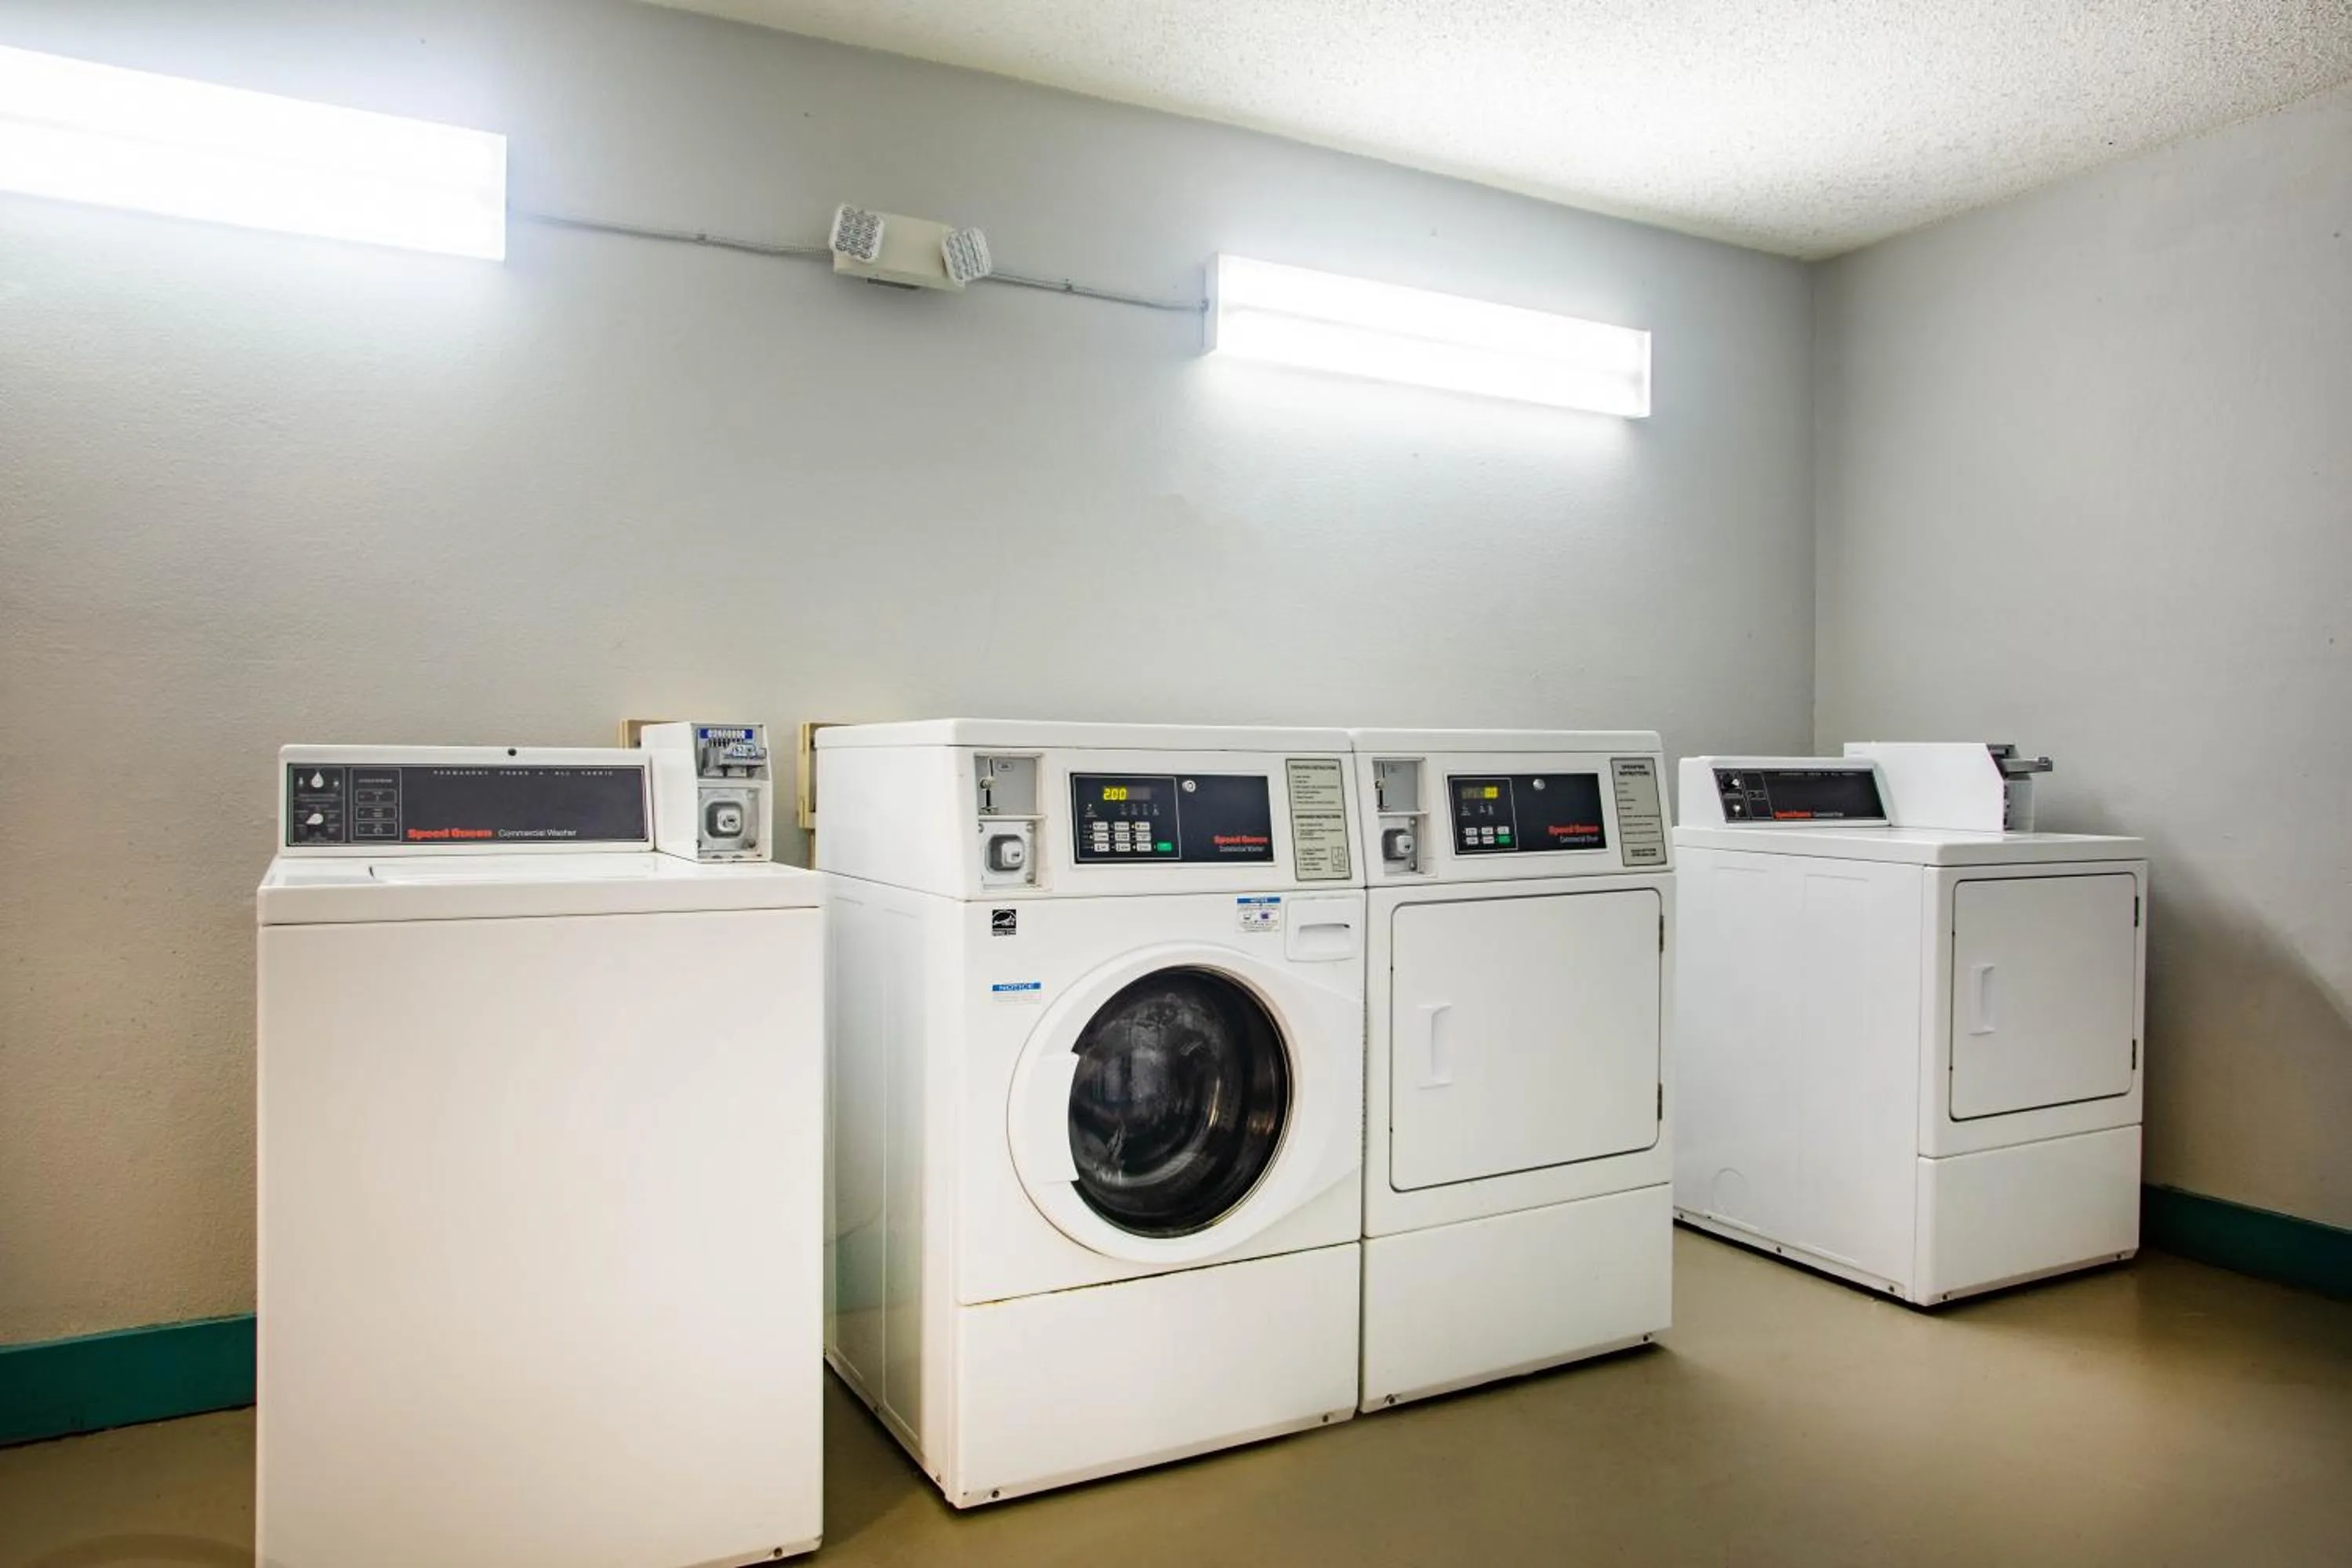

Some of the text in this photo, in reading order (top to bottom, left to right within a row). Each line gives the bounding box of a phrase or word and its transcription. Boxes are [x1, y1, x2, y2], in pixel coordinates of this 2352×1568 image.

[407, 827, 577, 840] Speed Queen Commercial Washer
